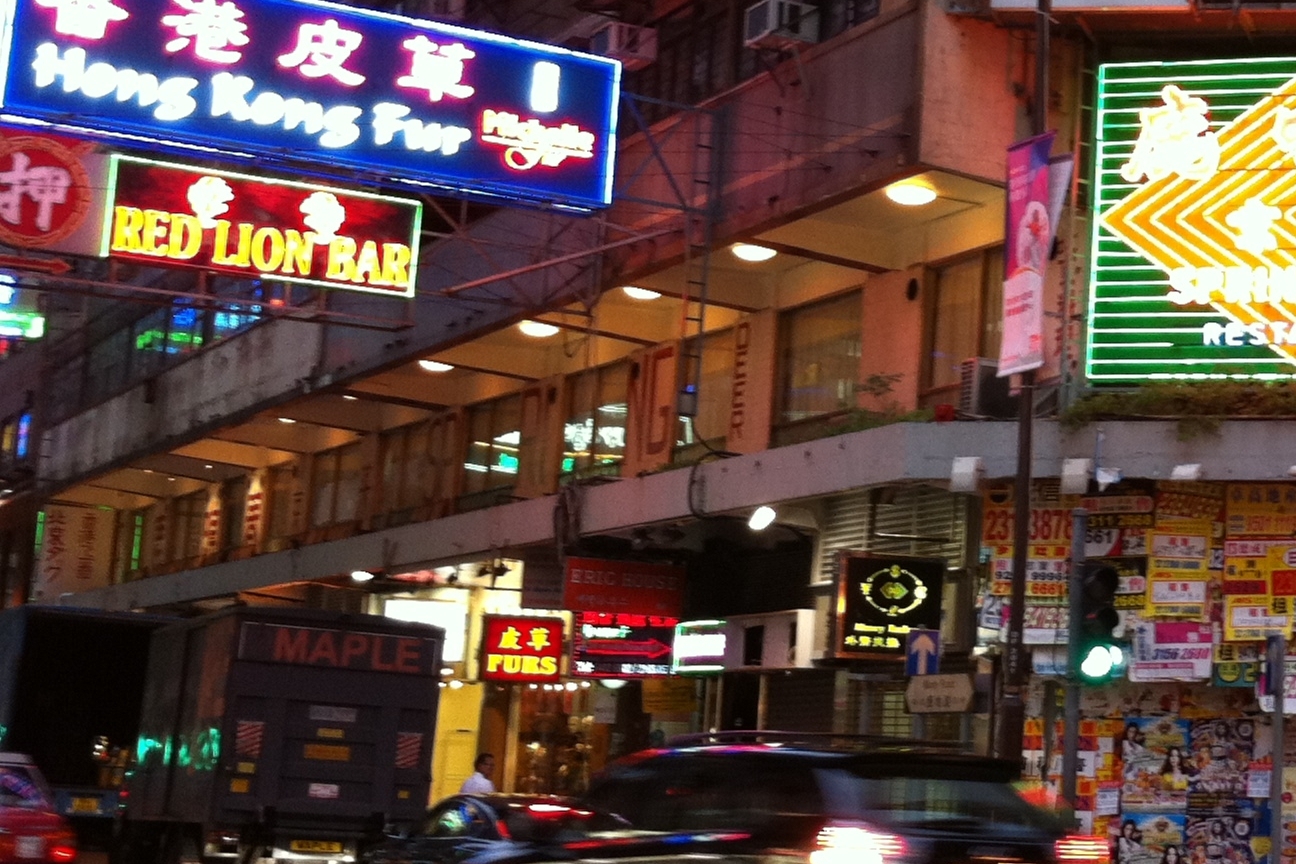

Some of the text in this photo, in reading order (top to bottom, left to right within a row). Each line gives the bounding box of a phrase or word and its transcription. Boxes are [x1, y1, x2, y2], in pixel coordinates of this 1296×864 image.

[31, 42, 472, 156] Hong Kong Fur
[0, 152, 71, 232] 押
[111, 206, 412, 288] RED LION BAR
[570, 567, 615, 586] ERIC
[272, 627, 422, 674] MAPLE
[486, 654, 558, 676] FURS
